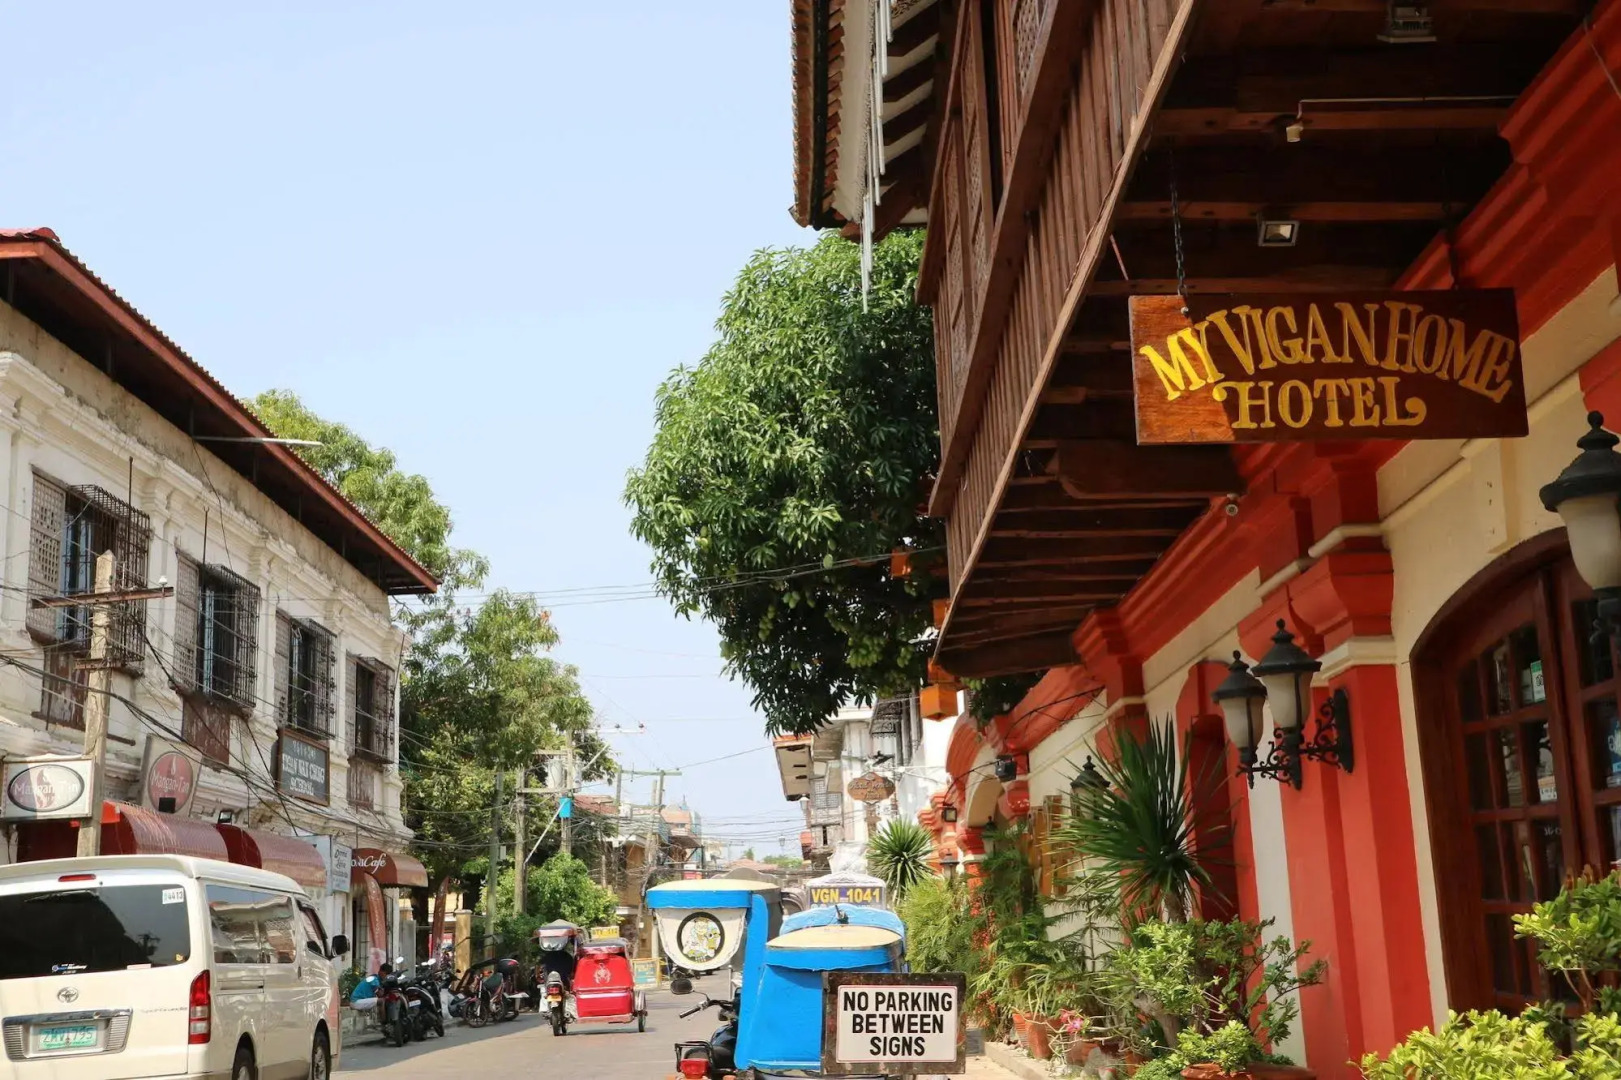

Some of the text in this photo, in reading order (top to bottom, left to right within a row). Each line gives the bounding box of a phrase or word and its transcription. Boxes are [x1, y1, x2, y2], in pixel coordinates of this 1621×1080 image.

[1139, 301, 1516, 404] MY VIGAN HOME
[1212, 376, 1427, 430] HOTEL
[811, 888, 880, 903] VGN 1041
[843, 991, 953, 1012] NO PARKING
[852, 1014, 944, 1034] BETWEEN
[869, 1036, 926, 1057] SIGNS
